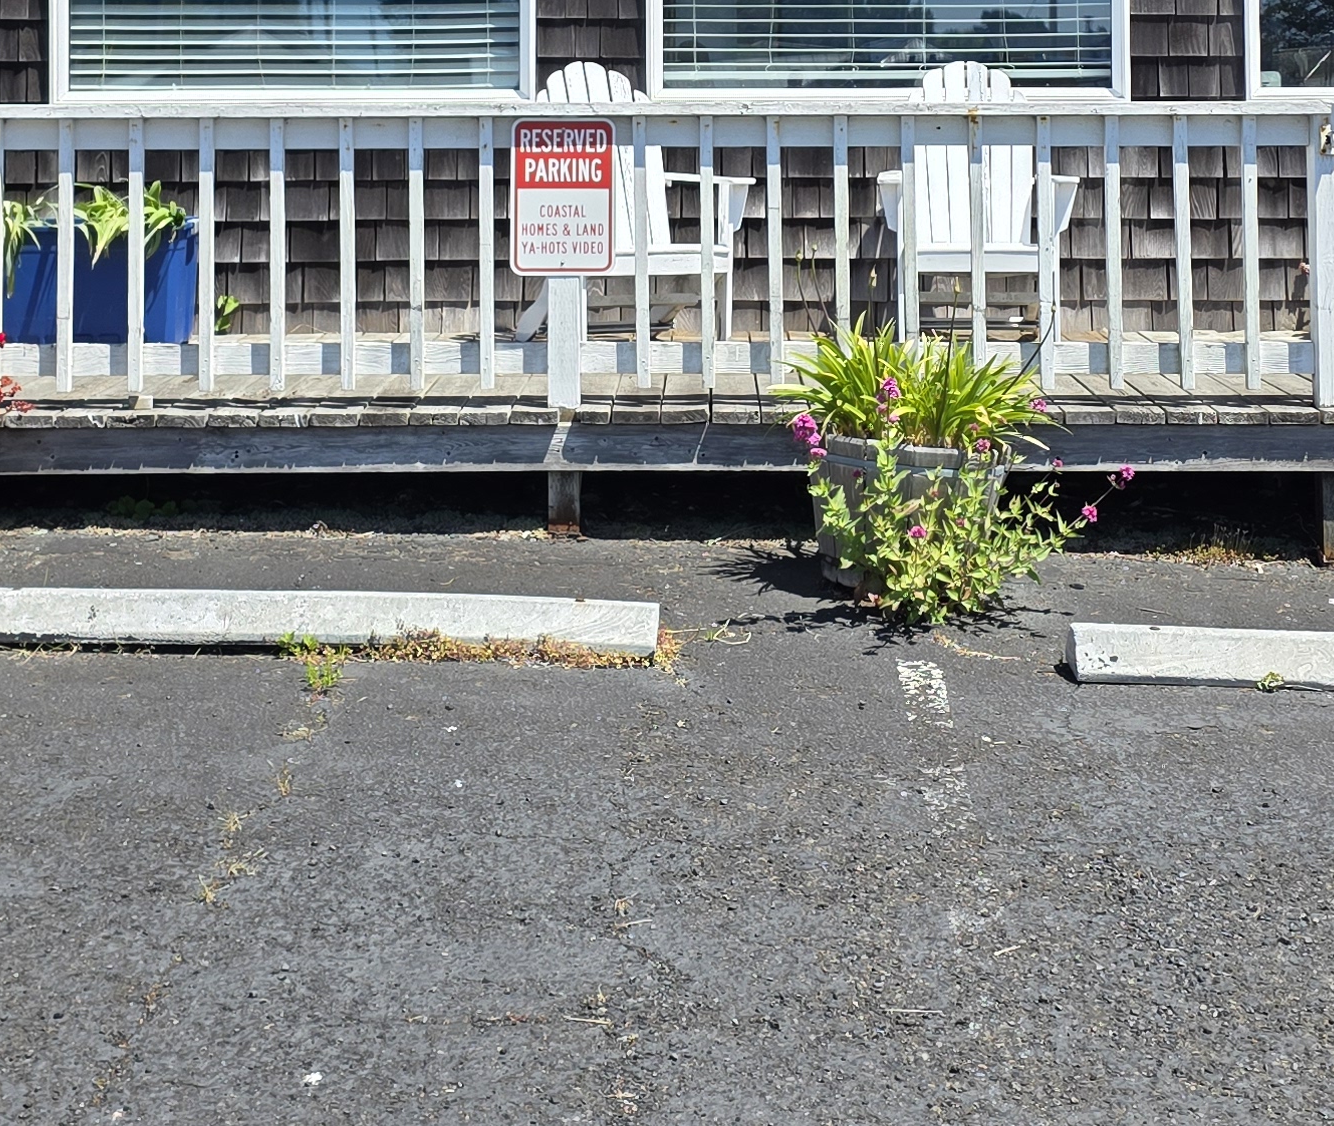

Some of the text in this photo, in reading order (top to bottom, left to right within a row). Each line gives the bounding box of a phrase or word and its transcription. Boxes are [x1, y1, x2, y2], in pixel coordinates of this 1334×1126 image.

[519, 128, 607, 153] RESERVED
[524, 157, 602, 182] PARKING
[539, 204, 586, 218] COASTAL
[521, 222, 604, 236] HOMES & LAND
[521, 241, 604, 254] YA-HOTS VIDEO
